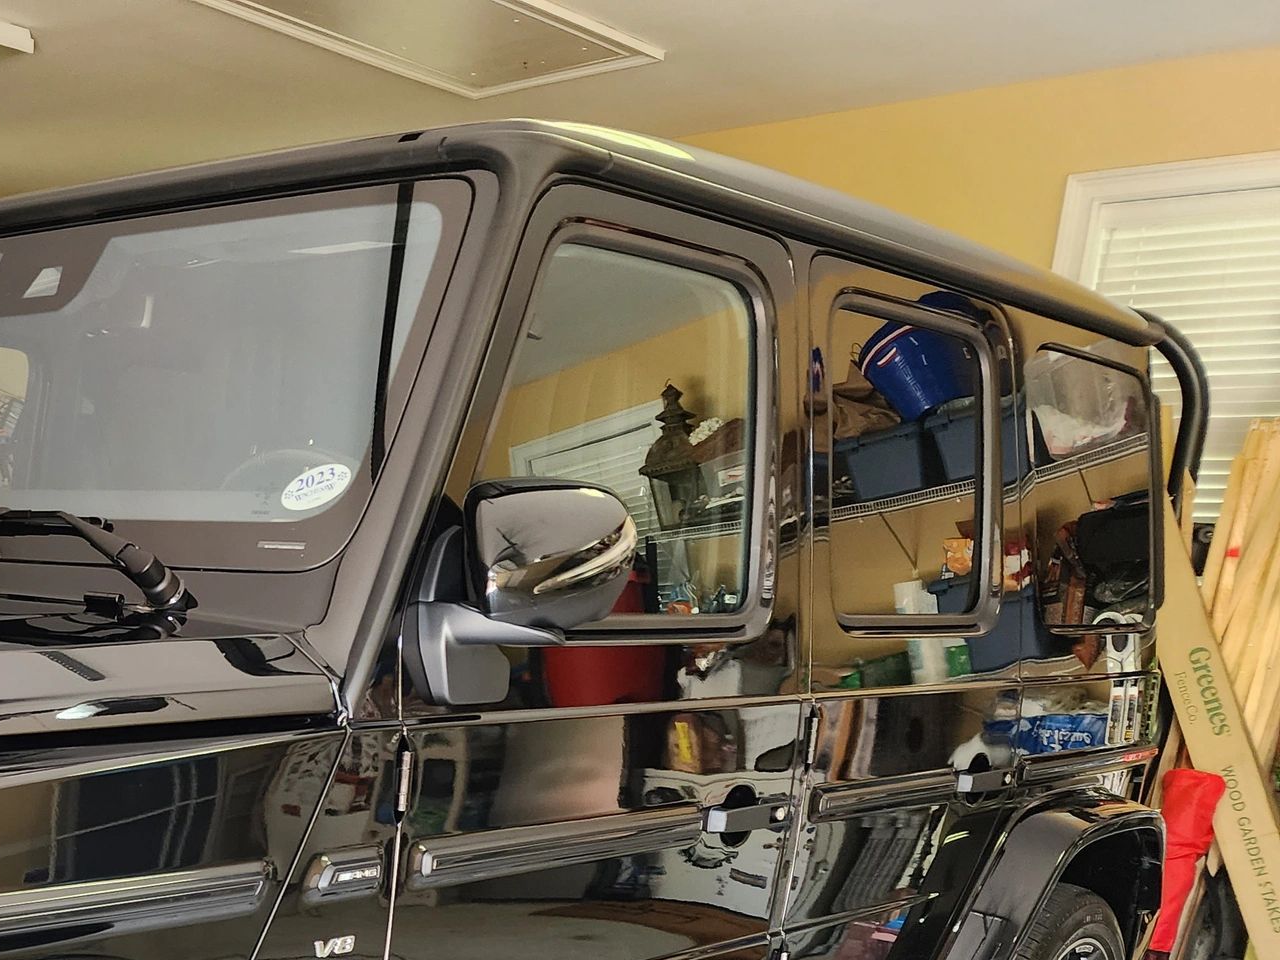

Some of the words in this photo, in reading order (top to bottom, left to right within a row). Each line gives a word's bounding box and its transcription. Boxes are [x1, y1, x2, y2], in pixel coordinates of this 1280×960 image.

[294, 467, 336, 492] 2023
[1221, 765, 1246, 812] WOOD
[1237, 816, 1268, 877] GARDEN
[314, 935, 355, 957] V8
